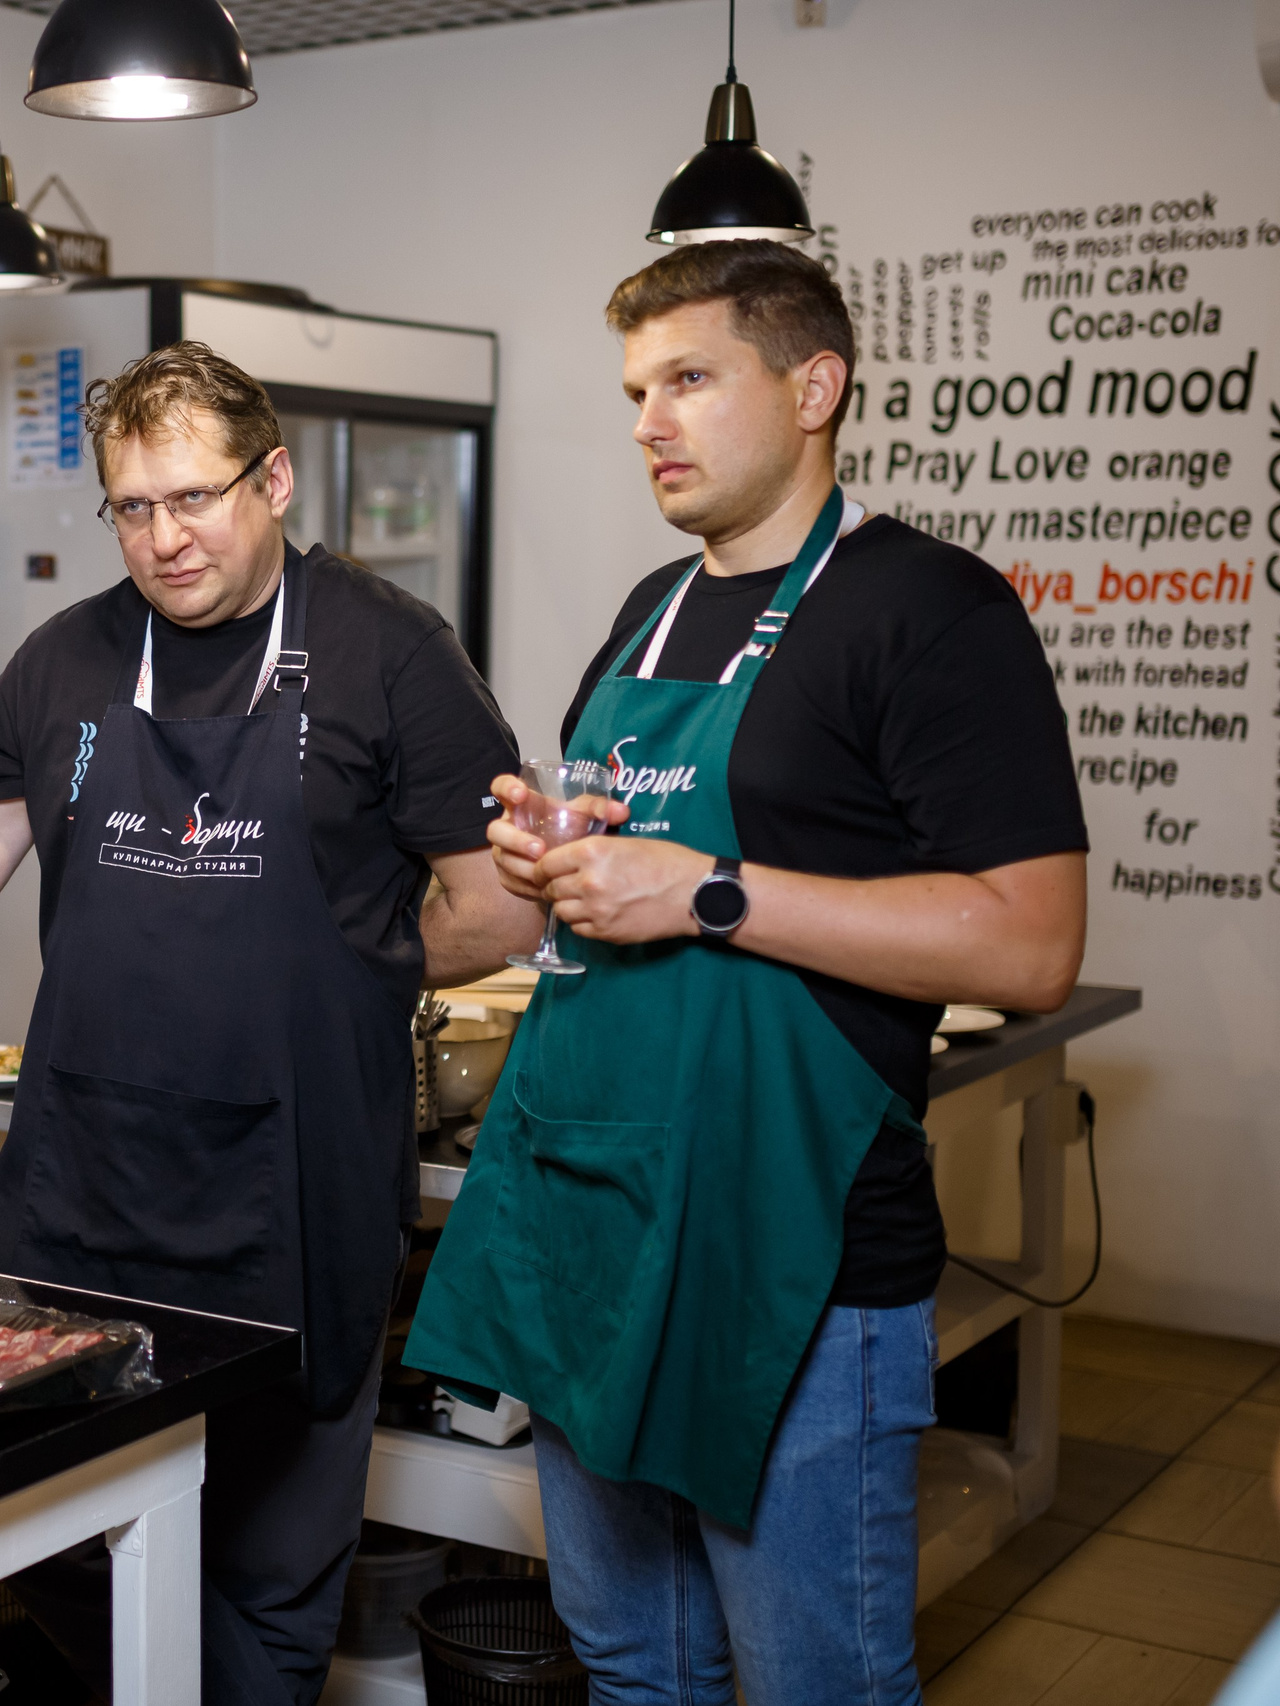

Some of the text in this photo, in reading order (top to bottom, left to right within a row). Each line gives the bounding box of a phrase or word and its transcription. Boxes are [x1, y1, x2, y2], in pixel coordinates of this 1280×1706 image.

[971, 191, 1218, 240] everyone can cook
[1032, 237, 1068, 262] the
[1074, 232, 1134, 261] most
[1138, 224, 1249, 254] delicious
[922, 250, 1007, 281] get up
[1023, 257, 1188, 301] mini cake
[1050, 300, 1221, 342] Coca-cola
[885, 380, 910, 421] a
[932, 358, 1072, 433] good
[1089, 351, 1257, 416] mood
[888, 443, 974, 493] Pray
[991, 441, 1088, 484] Love
[1109, 449, 1231, 487] orange
[1007, 502, 1252, 550] masterpiece
[1070, 624, 1115, 648] are
[1127, 618, 1172, 649] the
[1183, 618, 1250, 649] best
[1075, 658, 1125, 686] with
[1134, 661, 1248, 688] forehead
[1080, 705, 1124, 736] the
[1135, 706, 1248, 740] kitchen
[1078, 752, 1177, 791] recipe
[1146, 810, 1198, 845] for
[113, 852, 246, 873] КУЛИНАРНАЯ СТУДИЯ
[1113, 862, 1262, 900] happiness
